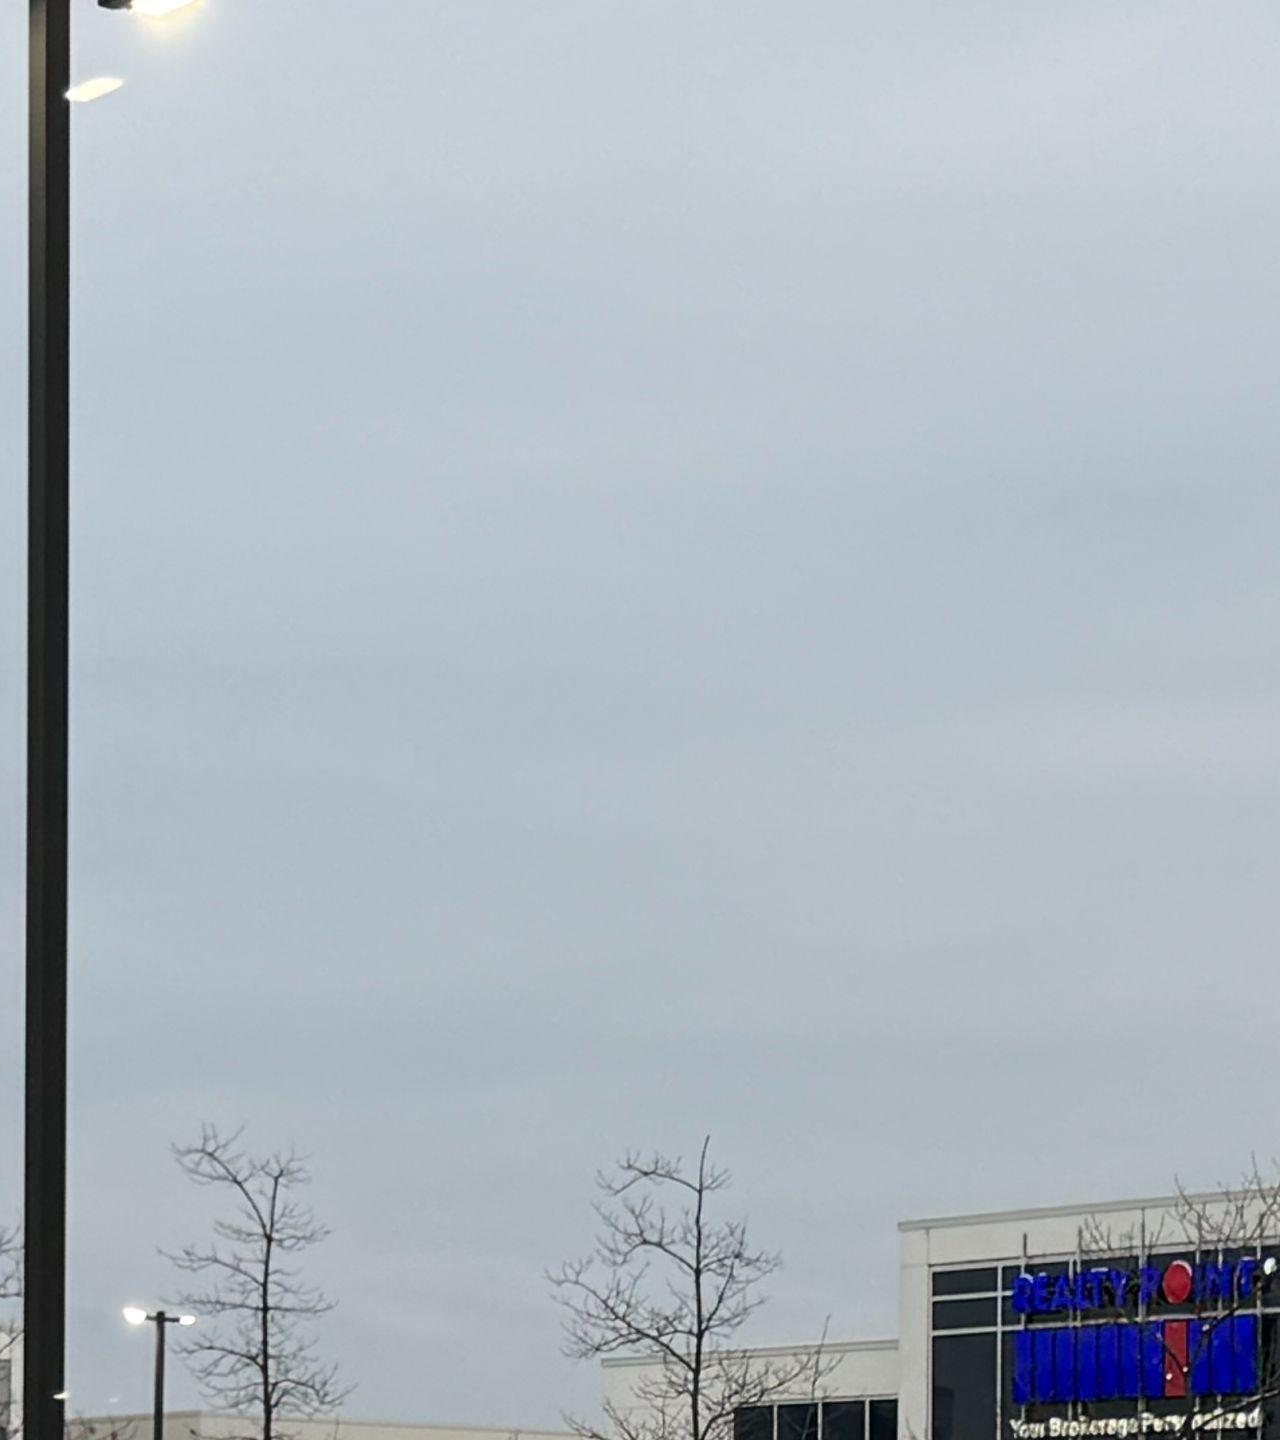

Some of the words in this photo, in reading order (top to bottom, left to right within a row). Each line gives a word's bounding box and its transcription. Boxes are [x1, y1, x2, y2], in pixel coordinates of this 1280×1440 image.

[1012, 1268, 1130, 1313] REALTY
[1010, 1418, 1045, 1439] Your
[1048, 1414, 1138, 1438] Brokerage
